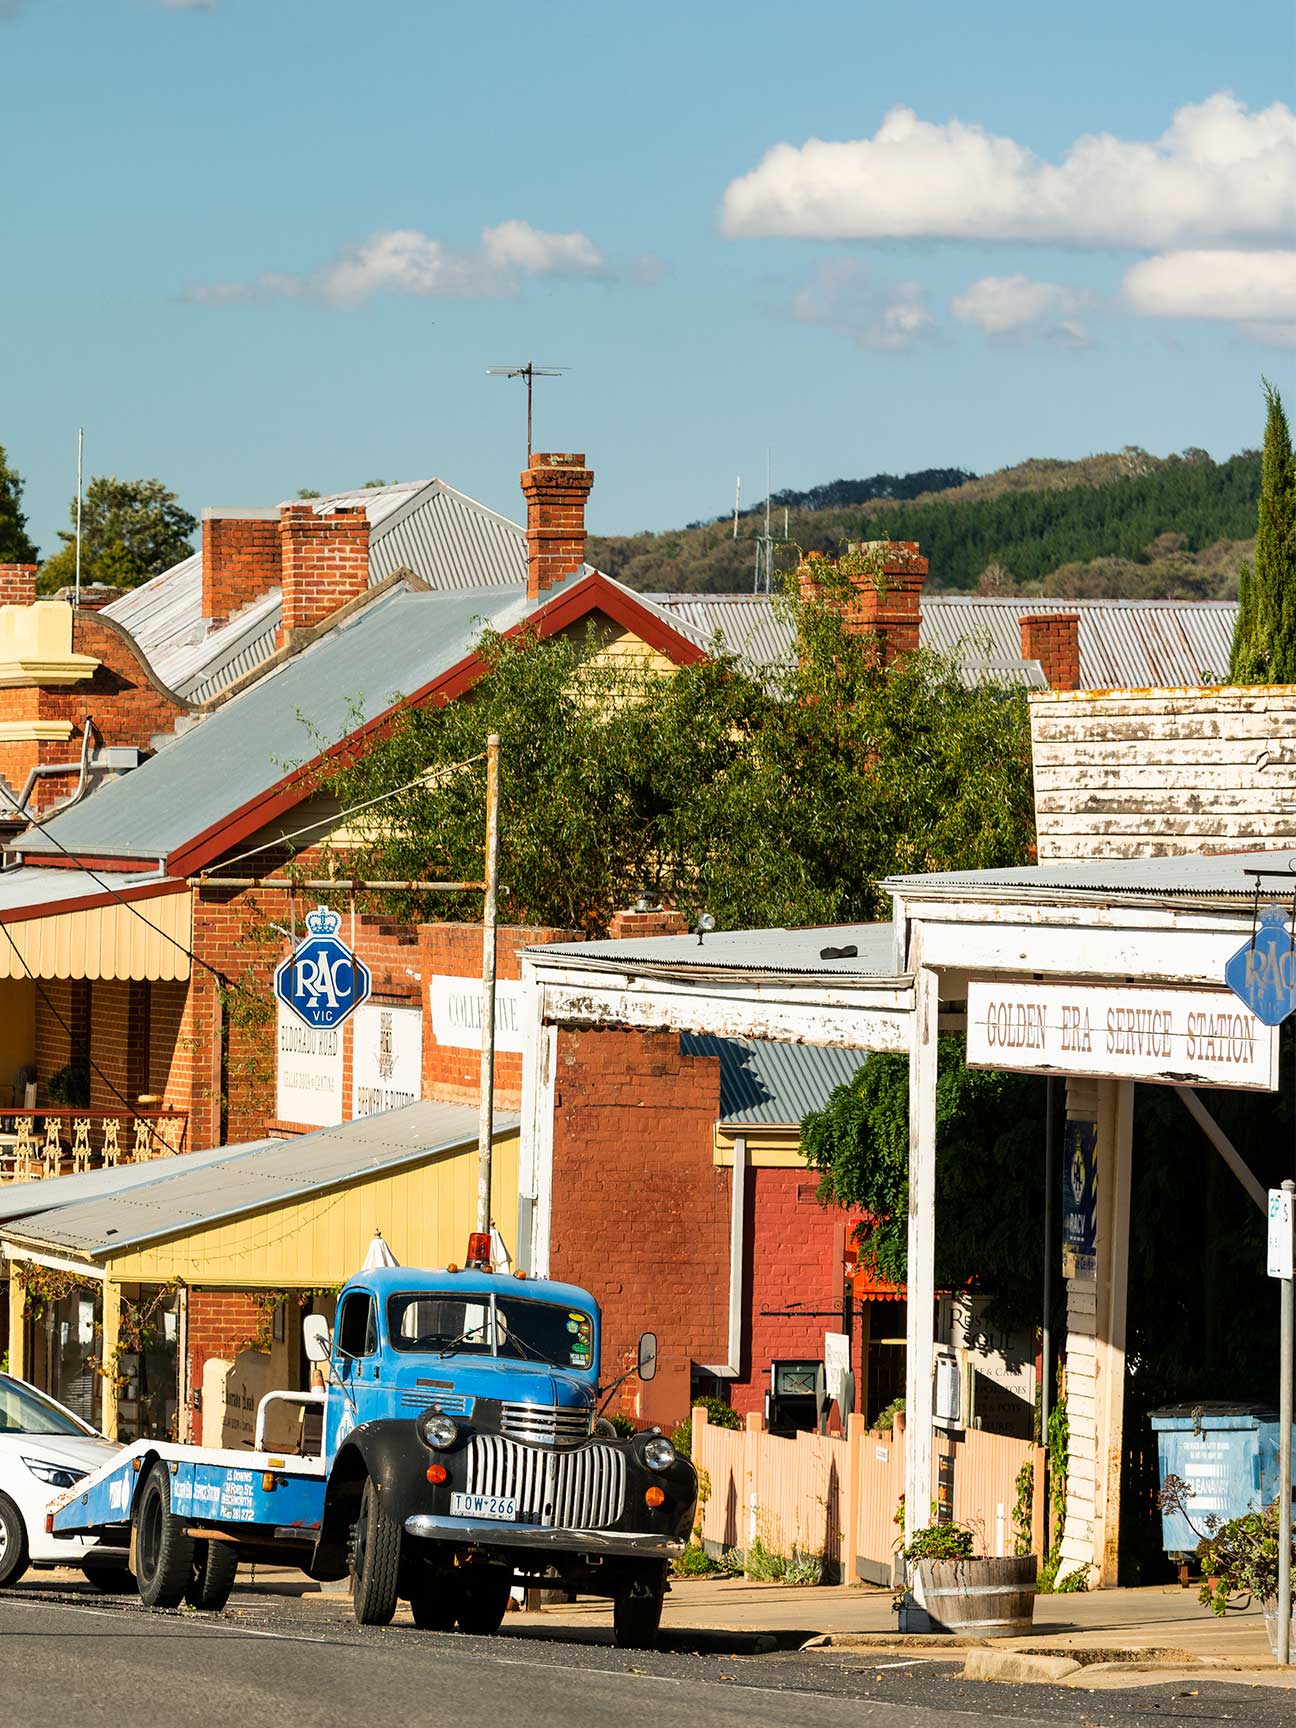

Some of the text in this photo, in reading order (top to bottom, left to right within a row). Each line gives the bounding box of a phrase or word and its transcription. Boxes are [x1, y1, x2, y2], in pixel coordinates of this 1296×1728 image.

[295, 950, 352, 1008] RAC
[312, 1010, 333, 1021] VIC
[987, 1002, 1256, 1064] GOLDEN ERA SERVICE STATION
[456, 1495, 514, 1514] TOW 266
